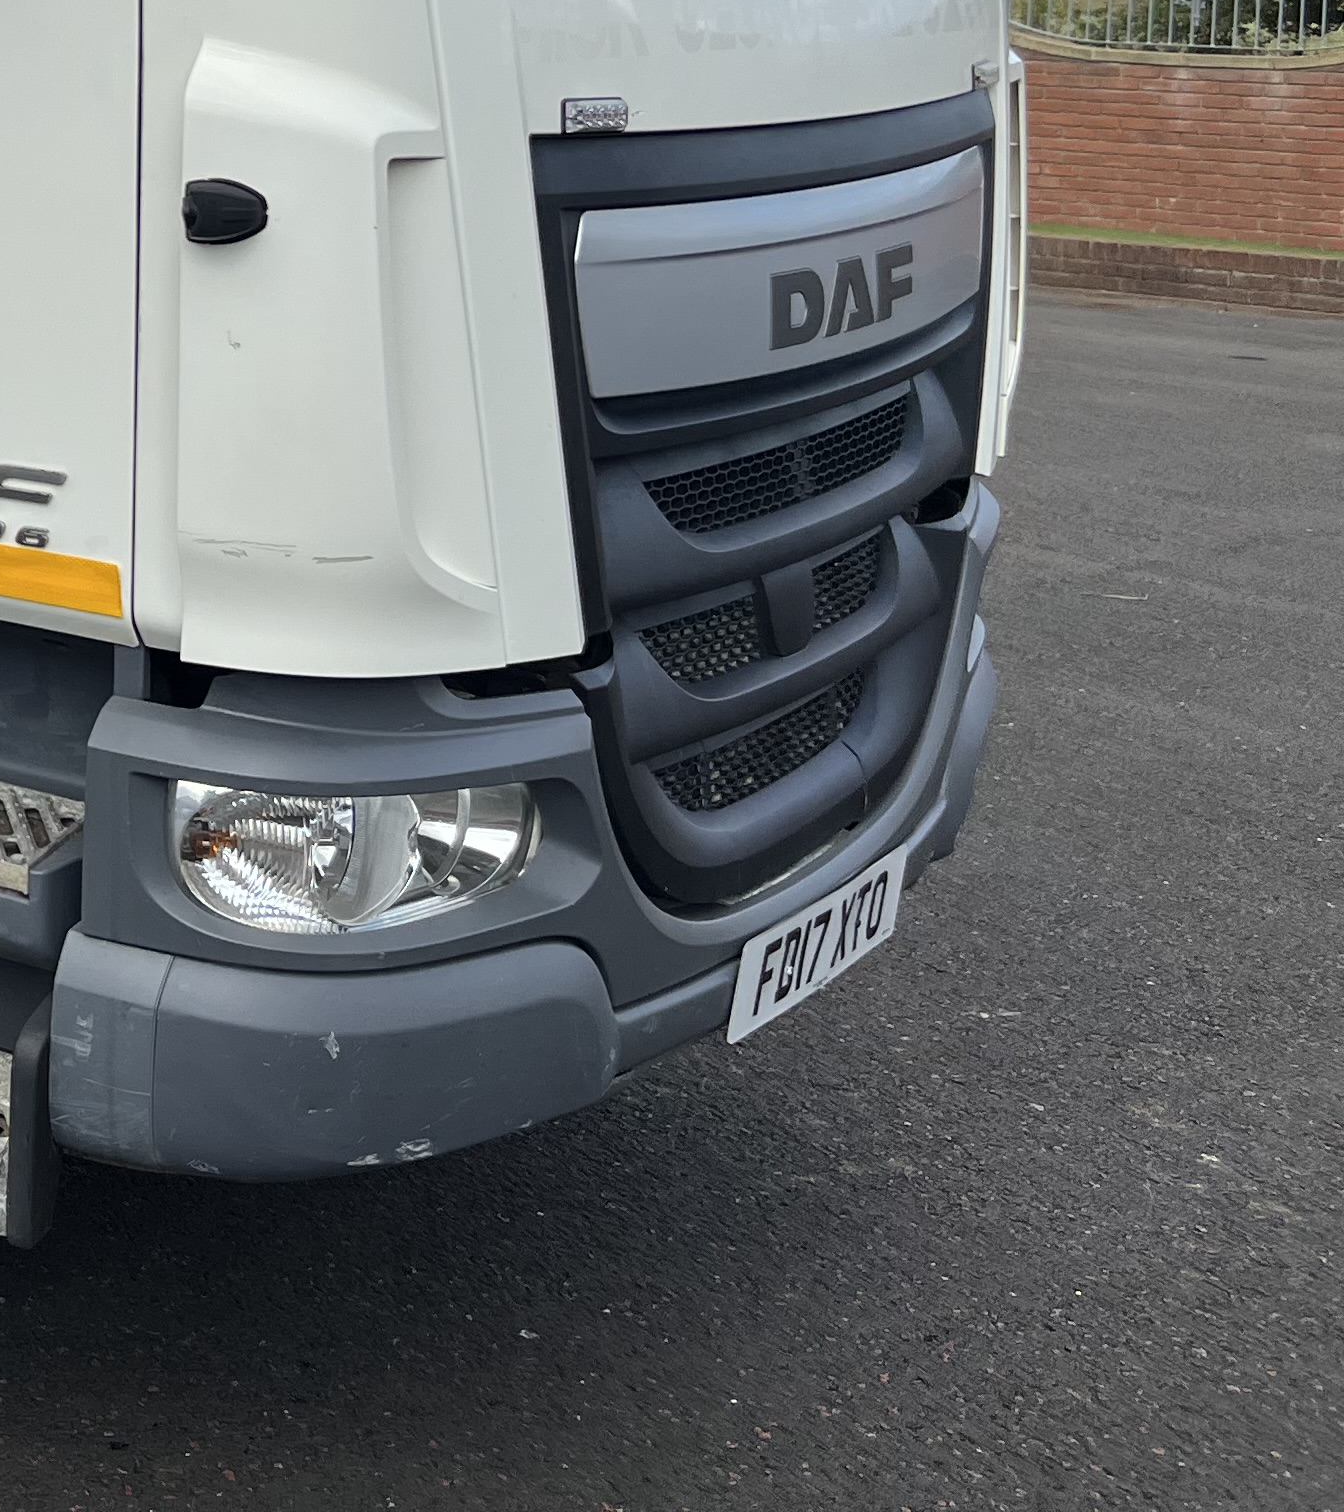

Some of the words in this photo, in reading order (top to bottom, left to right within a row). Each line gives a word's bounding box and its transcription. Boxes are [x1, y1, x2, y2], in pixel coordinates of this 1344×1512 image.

[768, 241, 913, 351] DAF
[14, 525, 50, 548] 6
[751, 907, 833, 1018] FD17
[829, 869, 889, 969] XFO
